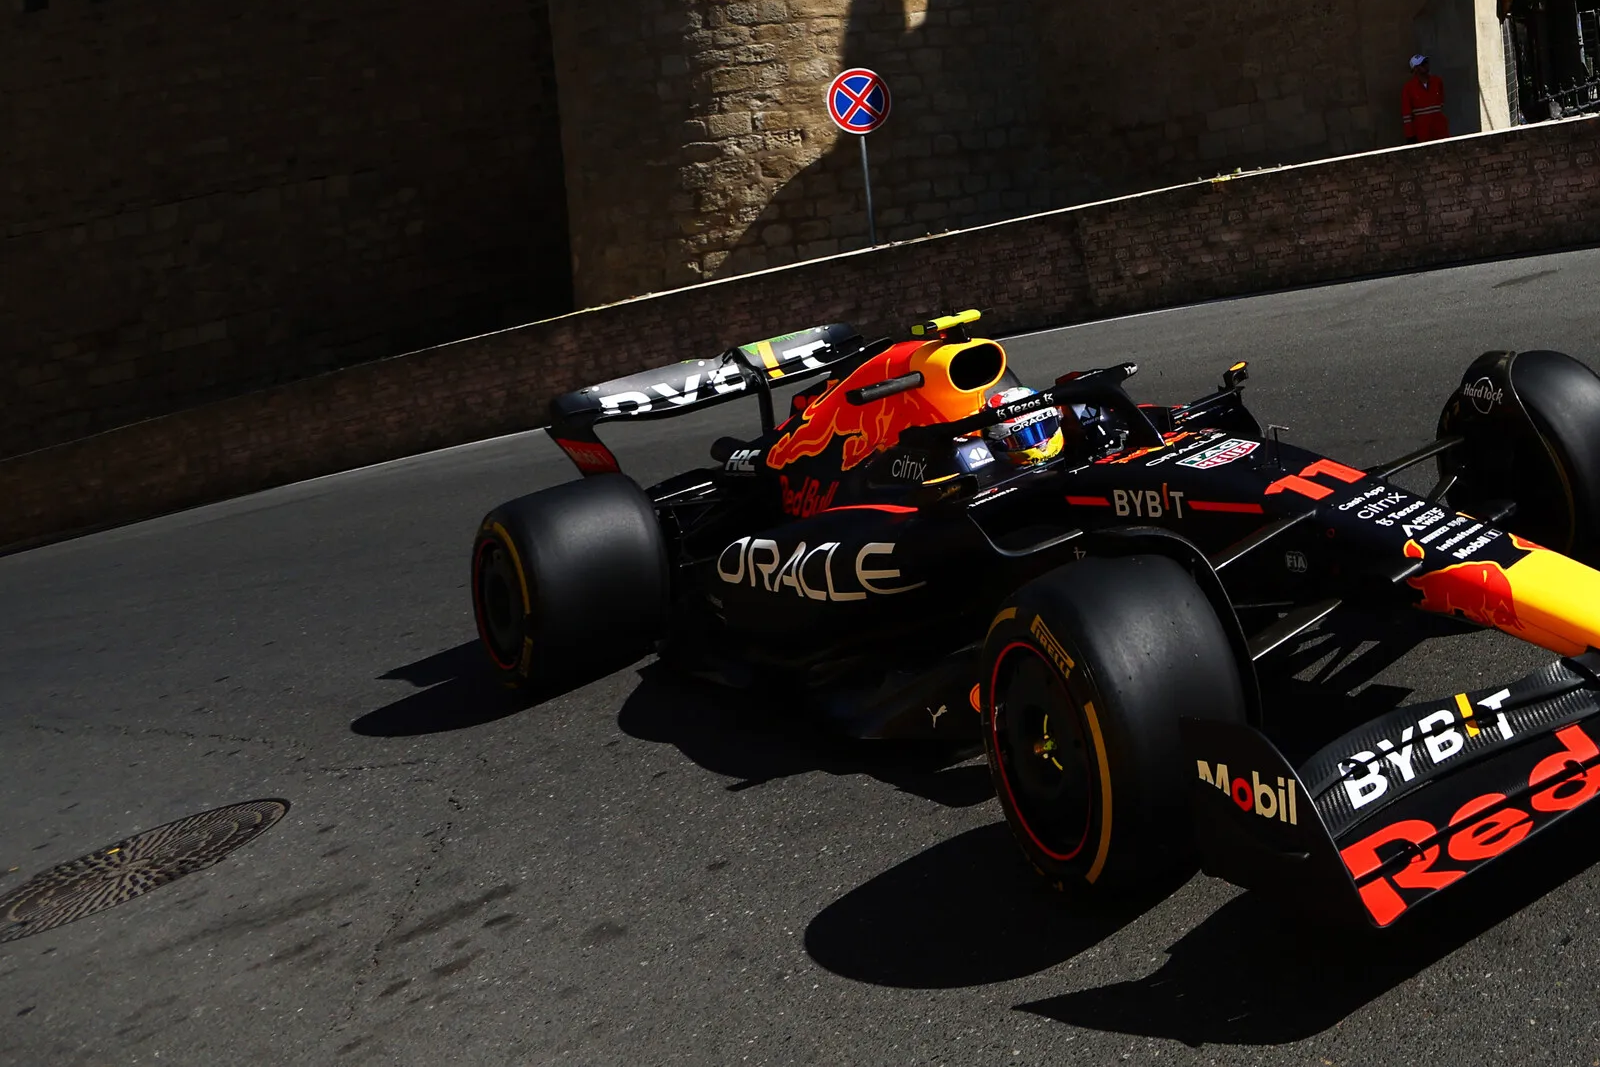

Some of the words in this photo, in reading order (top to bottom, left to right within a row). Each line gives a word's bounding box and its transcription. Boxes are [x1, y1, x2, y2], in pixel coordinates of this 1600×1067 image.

[1464, 383, 1484, 398] Hard
[1007, 398, 1041, 415] Tezos
[1011, 411, 1053, 432] ORACLE
[1146, 433, 1226, 466] ORACLE
[1185, 439, 1241, 465] TAG
[1197, 442, 1255, 468] HEUER
[891, 455, 927, 481] citrix
[1264, 459, 1367, 500] 11
[802, 477, 841, 518] Bull
[1113, 482, 1183, 519] BYBIT
[1339, 497, 1365, 511] Cash
[1363, 486, 1385, 499] App
[1357, 492, 1407, 519] citrix
[1391, 500, 1426, 520] Tezos
[1412, 507, 1442, 526] ARCTIC
[1421, 511, 1446, 527] WOLF
[1452, 535, 1492, 560] Mobil
[717, 536, 928, 602] ORACLE
[1286, 553, 1306, 571] FIA
[1030, 614, 1075, 679] PIRELLI
[1337, 688, 1514, 810] BYBIT
[1197, 760, 1297, 825] Mobil
